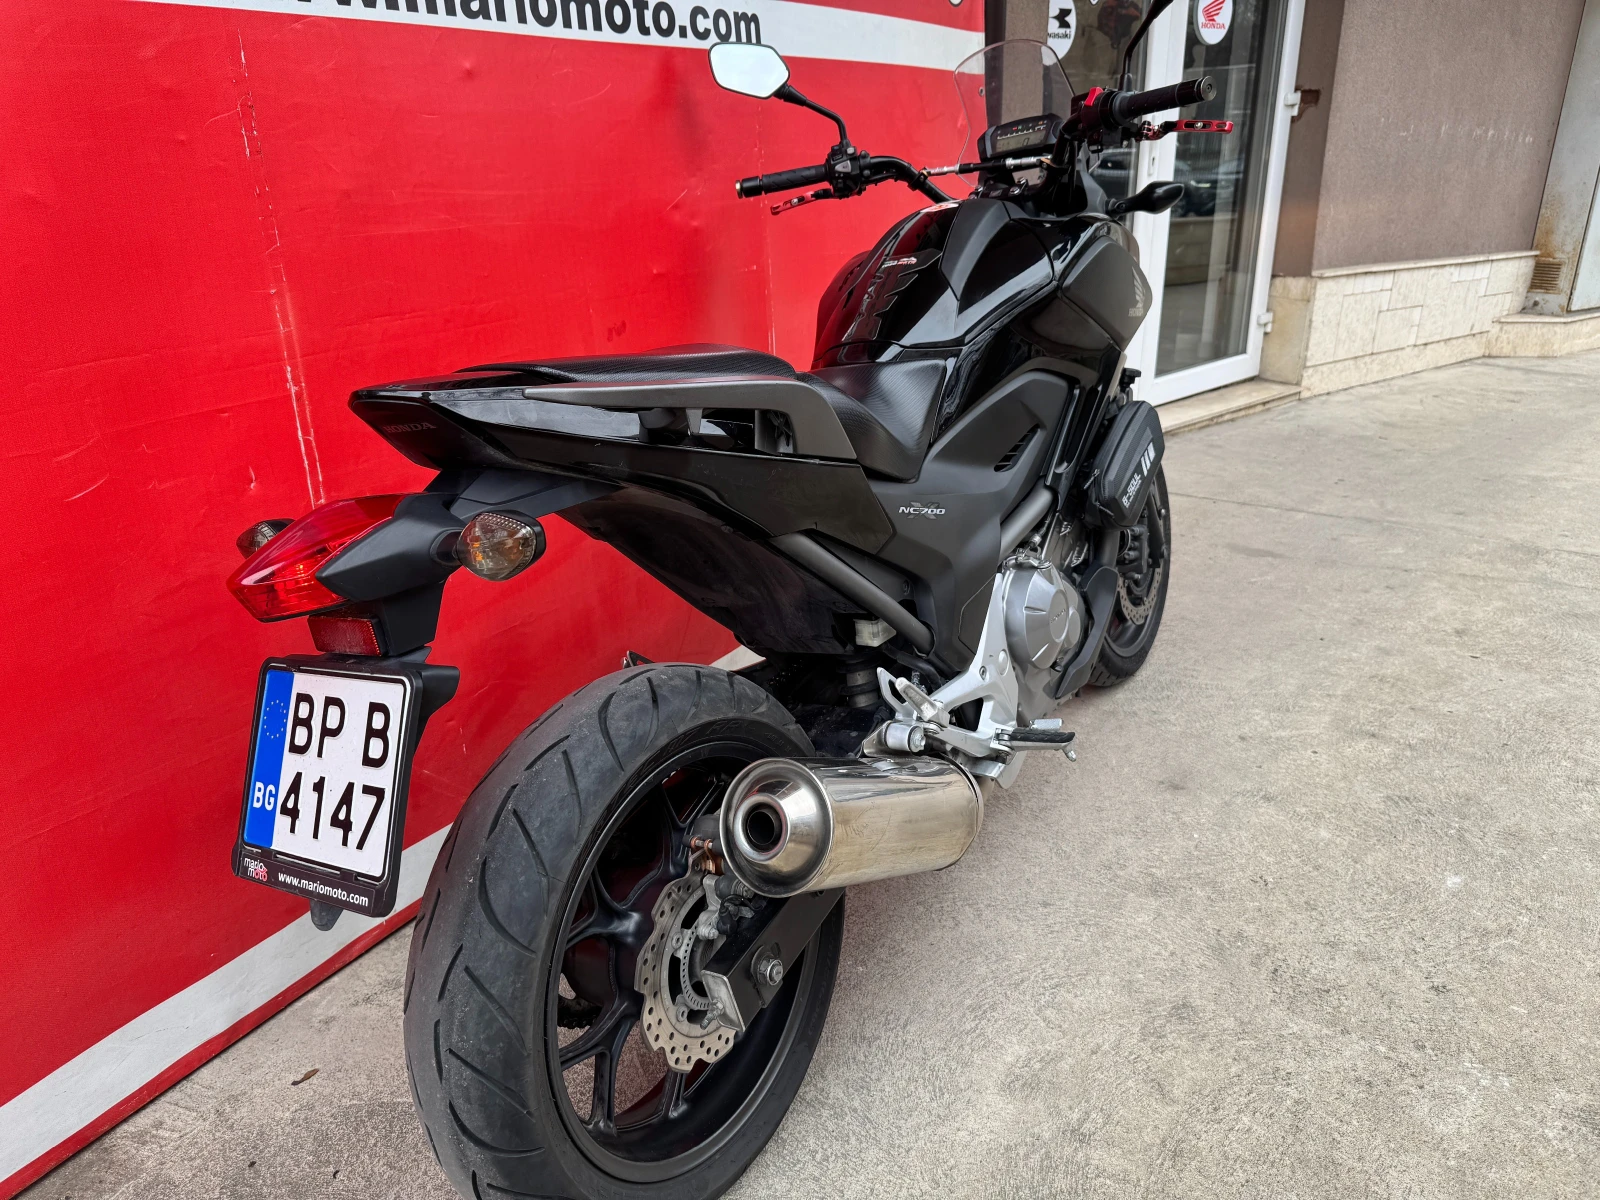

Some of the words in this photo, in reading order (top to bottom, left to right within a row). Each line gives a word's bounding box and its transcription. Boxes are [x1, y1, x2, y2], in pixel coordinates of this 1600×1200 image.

[1201, 22, 1226, 30] HONDA
[383, 422, 437, 433] HONDA
[899, 506, 946, 515] NC700
[288, 692, 346, 759] BP
[361, 701, 391, 768] B
[252, 781, 276, 811] BG
[279, 771, 386, 851] 4147
[244, 857, 265, 870] mario
[247, 867, 268, 881] moto
[278, 872, 368, 907] www.mariomoto.com
